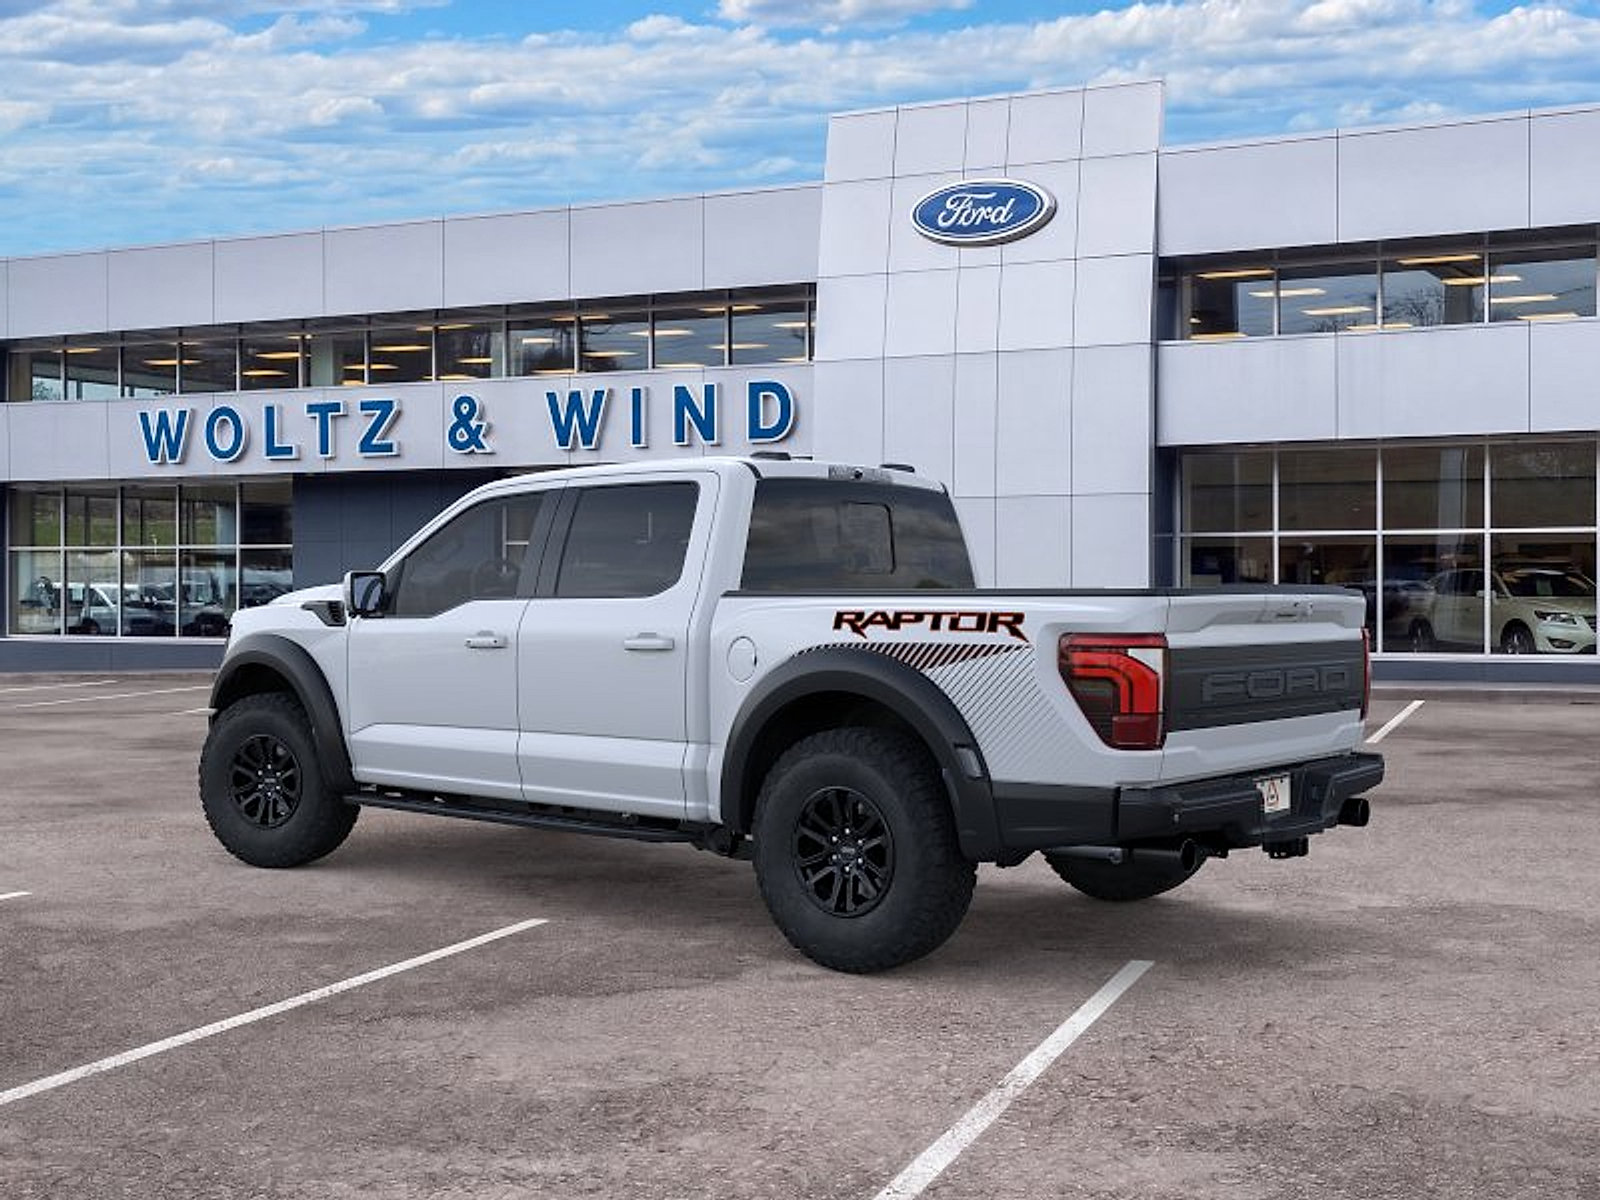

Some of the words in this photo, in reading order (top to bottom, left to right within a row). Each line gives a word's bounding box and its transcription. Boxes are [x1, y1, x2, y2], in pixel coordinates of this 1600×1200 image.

[937, 191, 1015, 226] Ford
[139, 399, 400, 464] WOLTZ
[447, 395, 492, 454] &
[546, 380, 797, 450] WIND
[832, 610, 1029, 643] RAPTOR
[1202, 667, 1350, 703] FORD
